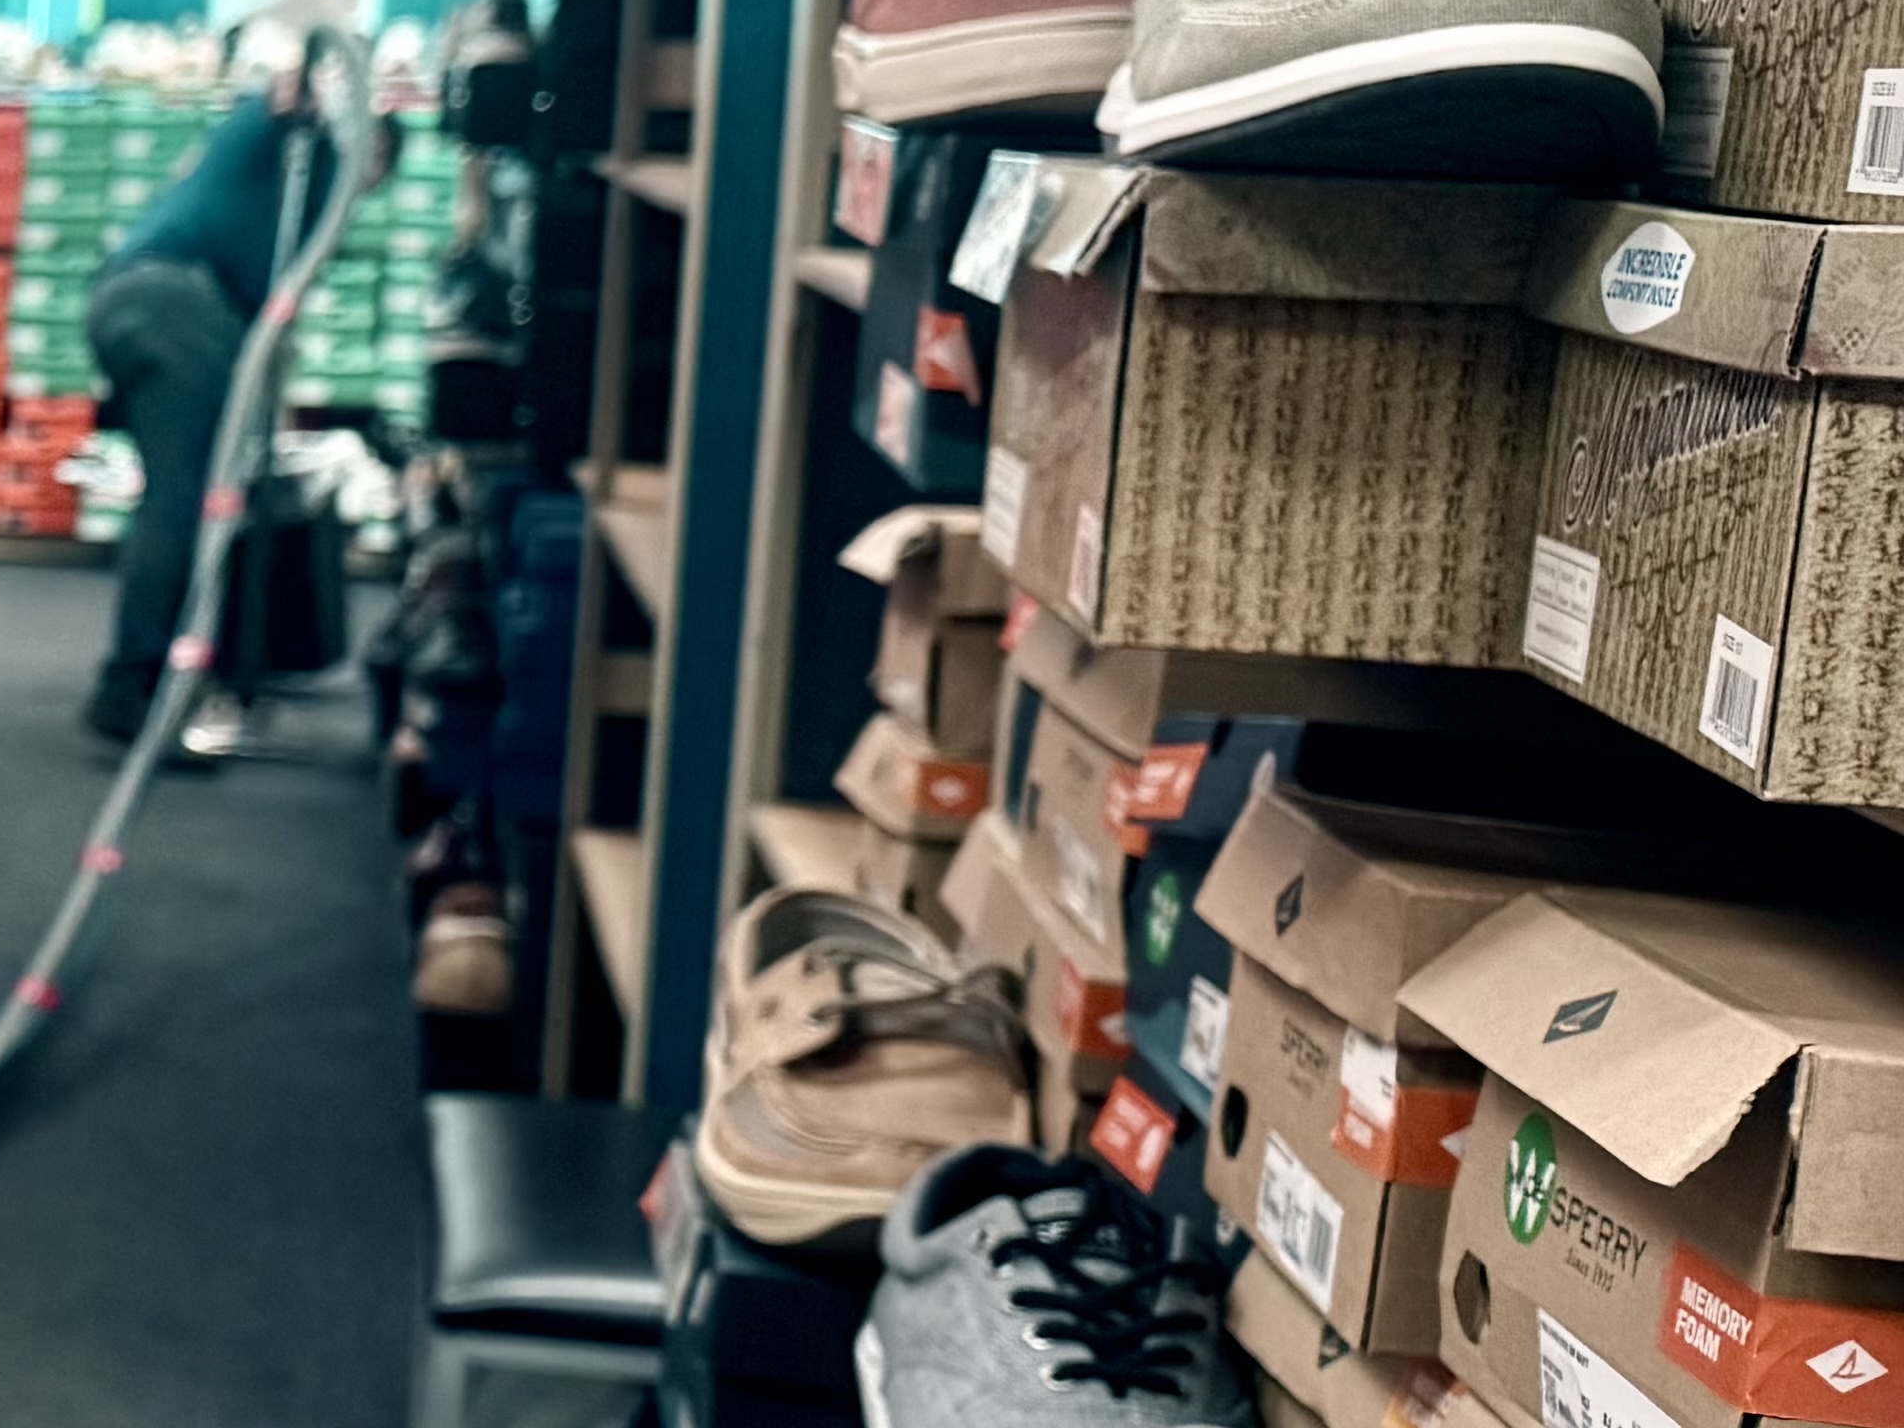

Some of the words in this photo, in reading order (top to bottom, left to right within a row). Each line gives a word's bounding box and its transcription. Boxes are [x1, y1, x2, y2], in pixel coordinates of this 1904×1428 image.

[1617, 248, 1686, 280] INCREDIBLE
[1550, 1186, 1648, 1280] SPERRY
[1675, 1308, 1721, 1362] FOAM
[1680, 1276, 1753, 1346] MEMORY
